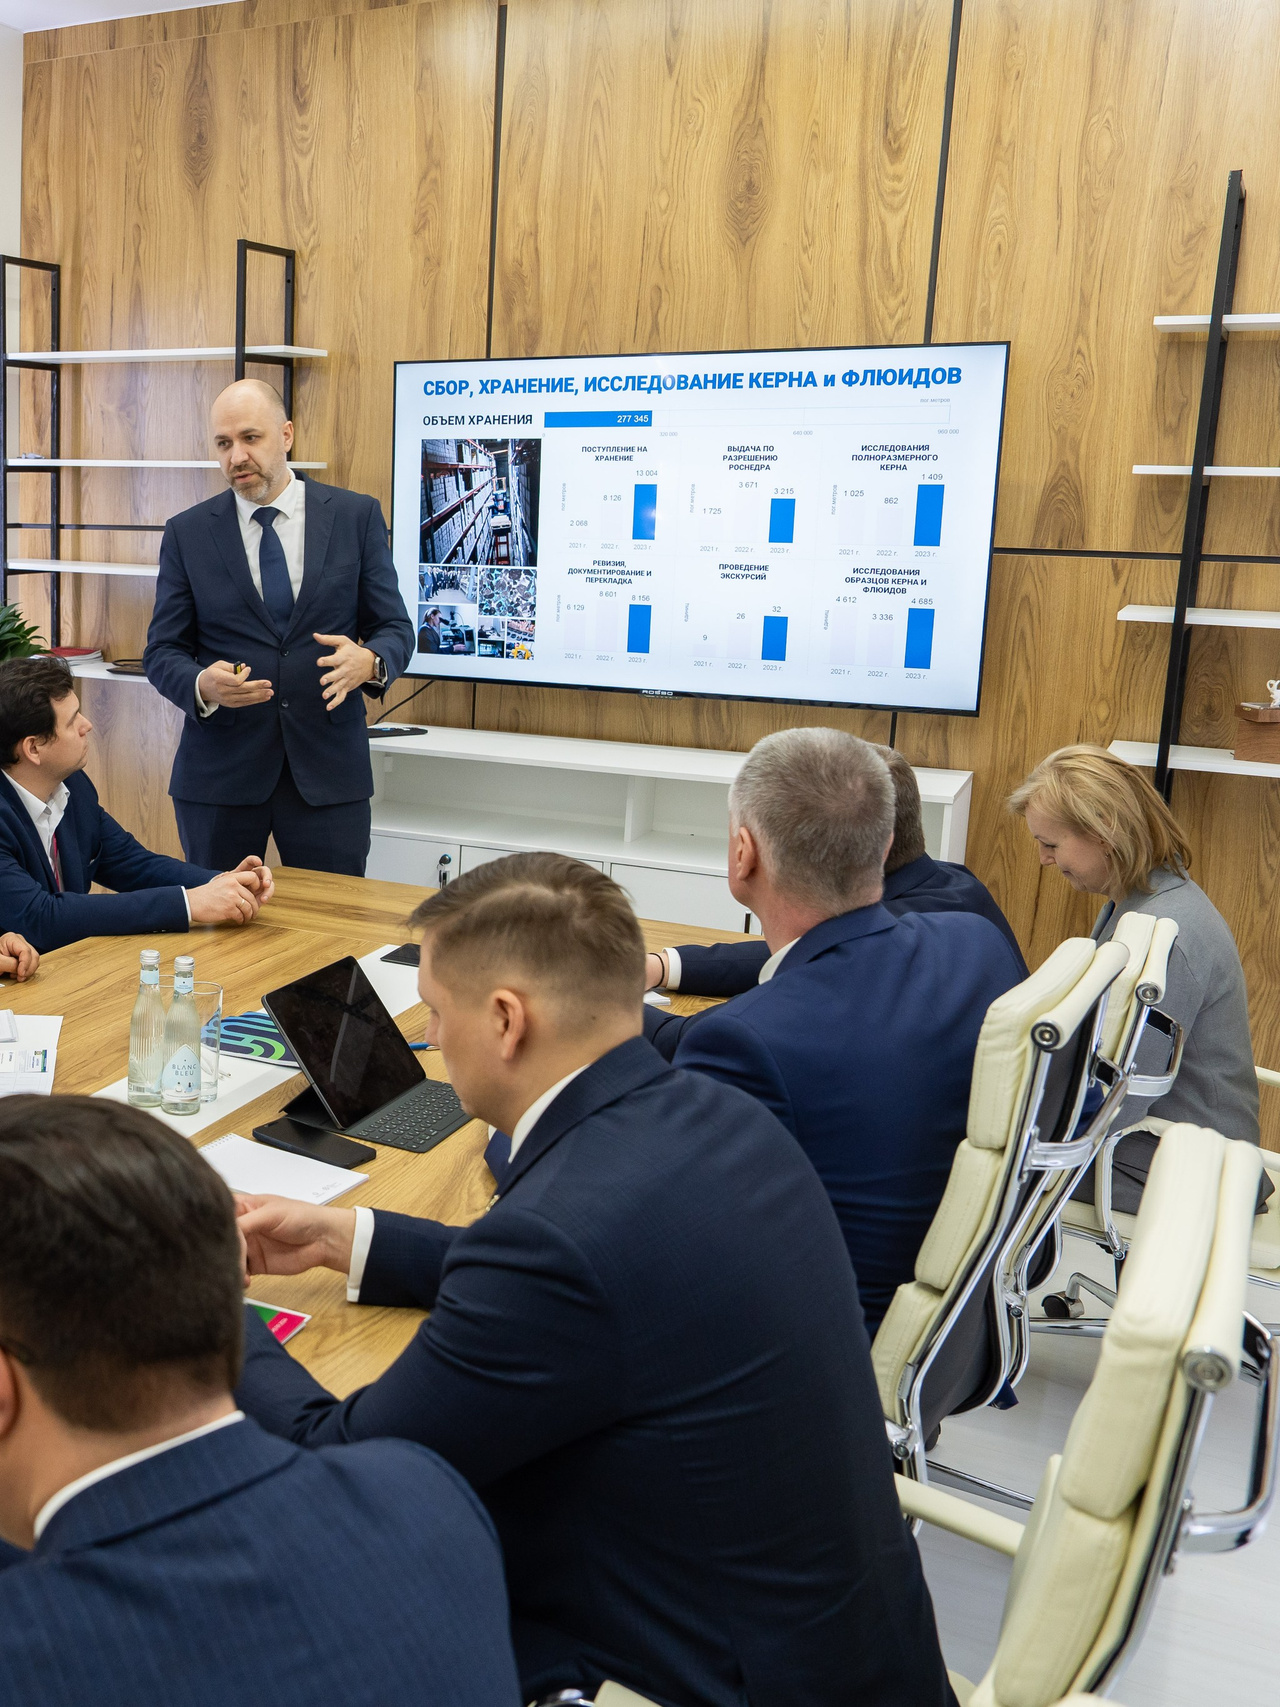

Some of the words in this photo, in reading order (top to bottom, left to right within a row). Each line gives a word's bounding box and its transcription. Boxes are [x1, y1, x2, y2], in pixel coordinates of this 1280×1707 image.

[423, 380, 474, 398] СБОР,
[478, 377, 579, 396] ХРАНЕНИЕ,
[584, 373, 744, 394] ИССЛЕДОВАНИЕ
[748, 370, 818, 388] КЕРНА
[823, 373, 836, 388] и
[841, 366, 963, 388] ФЛЮИДОВ
[422, 415, 465, 426] ОБЪЕМ
[468, 414, 533, 426] ХРАНЕНИЯ
[616, 414, 632, 423] 277
[634, 414, 649, 423] 345
[592, 560, 626, 568] РЕВИЗИЯ,
[718, 563, 769, 571] ПРОВЕДЕНИЕ
[568, 568, 645, 576] ДОКУМЕНТИРОВАНИЕ
[852, 568, 920, 576] ИССЛЕДОВАНИЯ
[844, 577, 890, 585] ОБРАЗЦОВ
[862, 586, 907, 595] ФЛЮИДОВ
